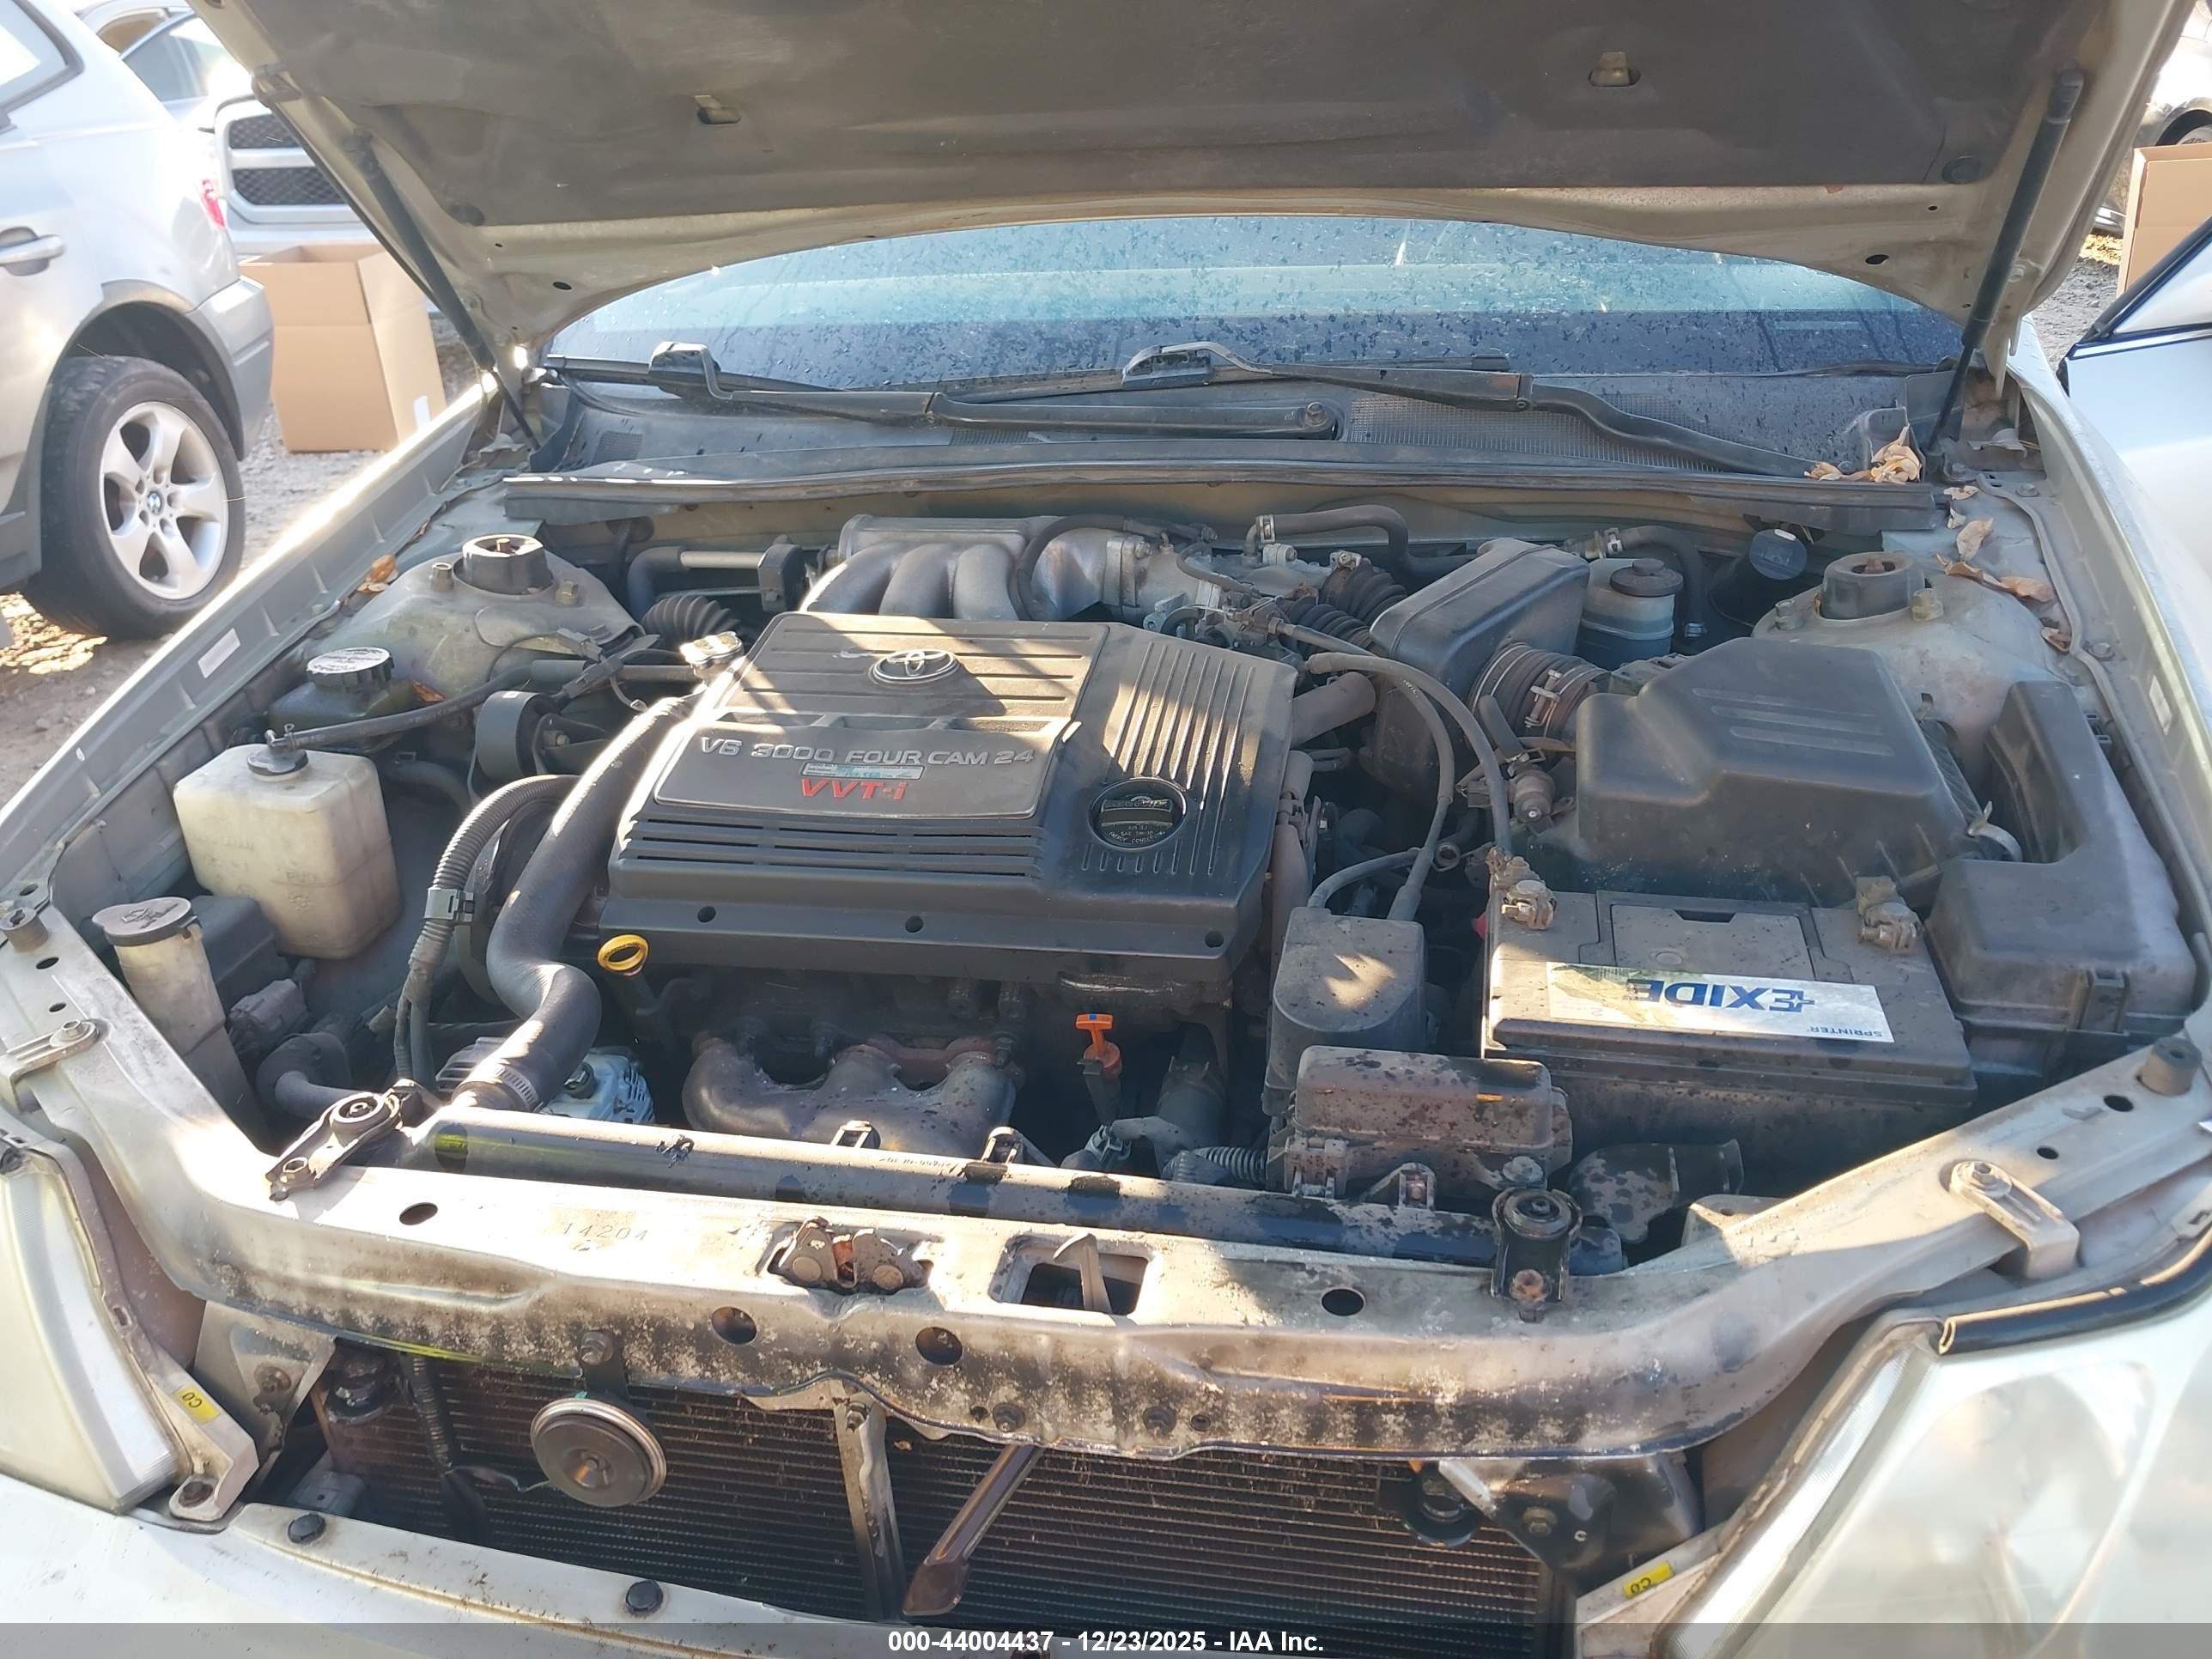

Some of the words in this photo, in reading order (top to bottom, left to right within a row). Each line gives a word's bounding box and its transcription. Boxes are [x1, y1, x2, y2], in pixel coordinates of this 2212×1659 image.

[701, 737, 742, 757] V6
[751, 744, 836, 762] 3000
[845, 749, 921, 765] FOUR
[927, 750, 988, 765] CAM
[994, 749, 1034, 765] 24
[801, 778, 908, 799] VVT-i
[1626, 978, 1814, 1013] EXIDE
[1808, 1025, 1883, 1038] SPRINTER
[562, 1222, 648, 1242] 14204
